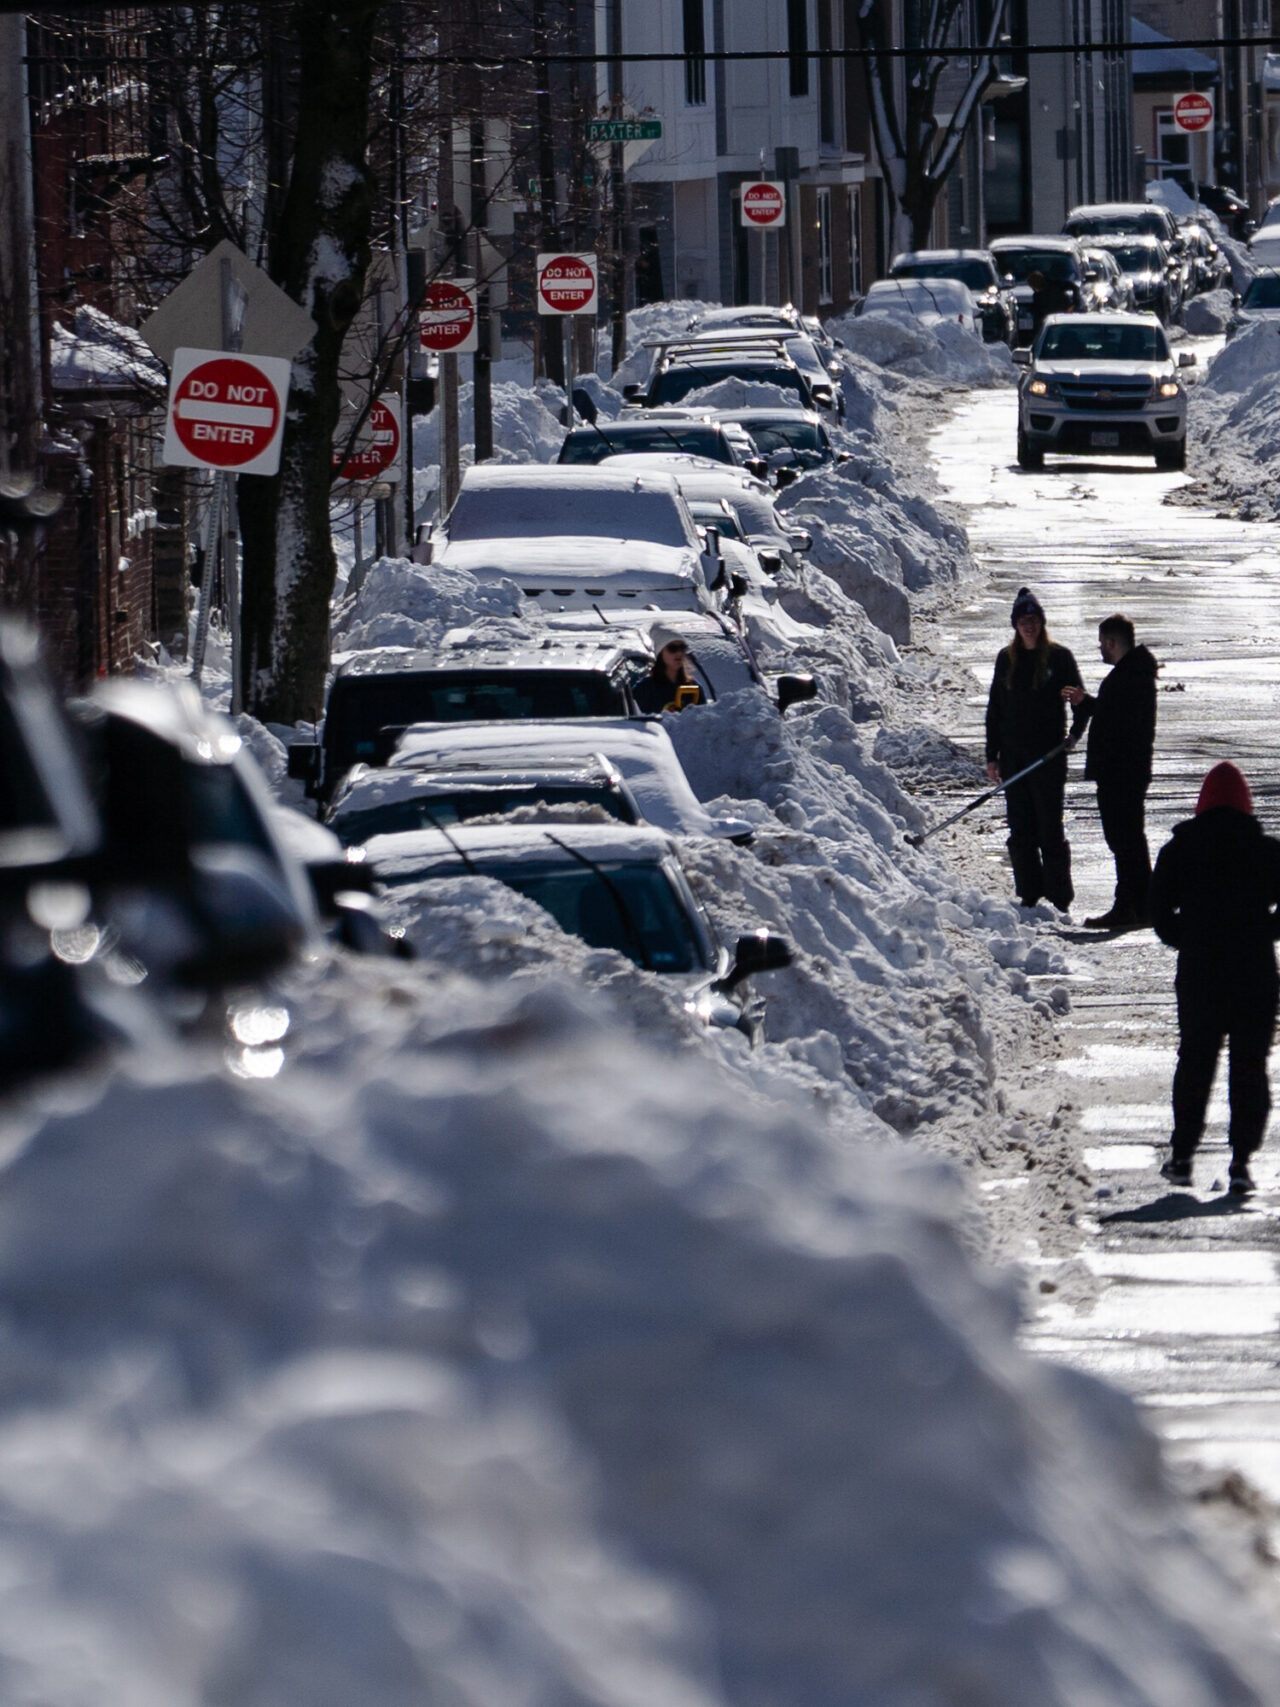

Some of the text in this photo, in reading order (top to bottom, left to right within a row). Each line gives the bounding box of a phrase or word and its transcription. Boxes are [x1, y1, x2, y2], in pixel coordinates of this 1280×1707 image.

[590, 124, 642, 139] BAXTER
[762, 192, 777, 200] NOT
[547, 267, 587, 278] DO NOT
[550, 291, 585, 300] ENTER
[440, 297, 465, 309] NOT
[421, 324, 460, 335] ENTER
[190, 380, 268, 403] DO NOT
[369, 410, 386, 424] OT
[193, 424, 255, 445] ENTER
